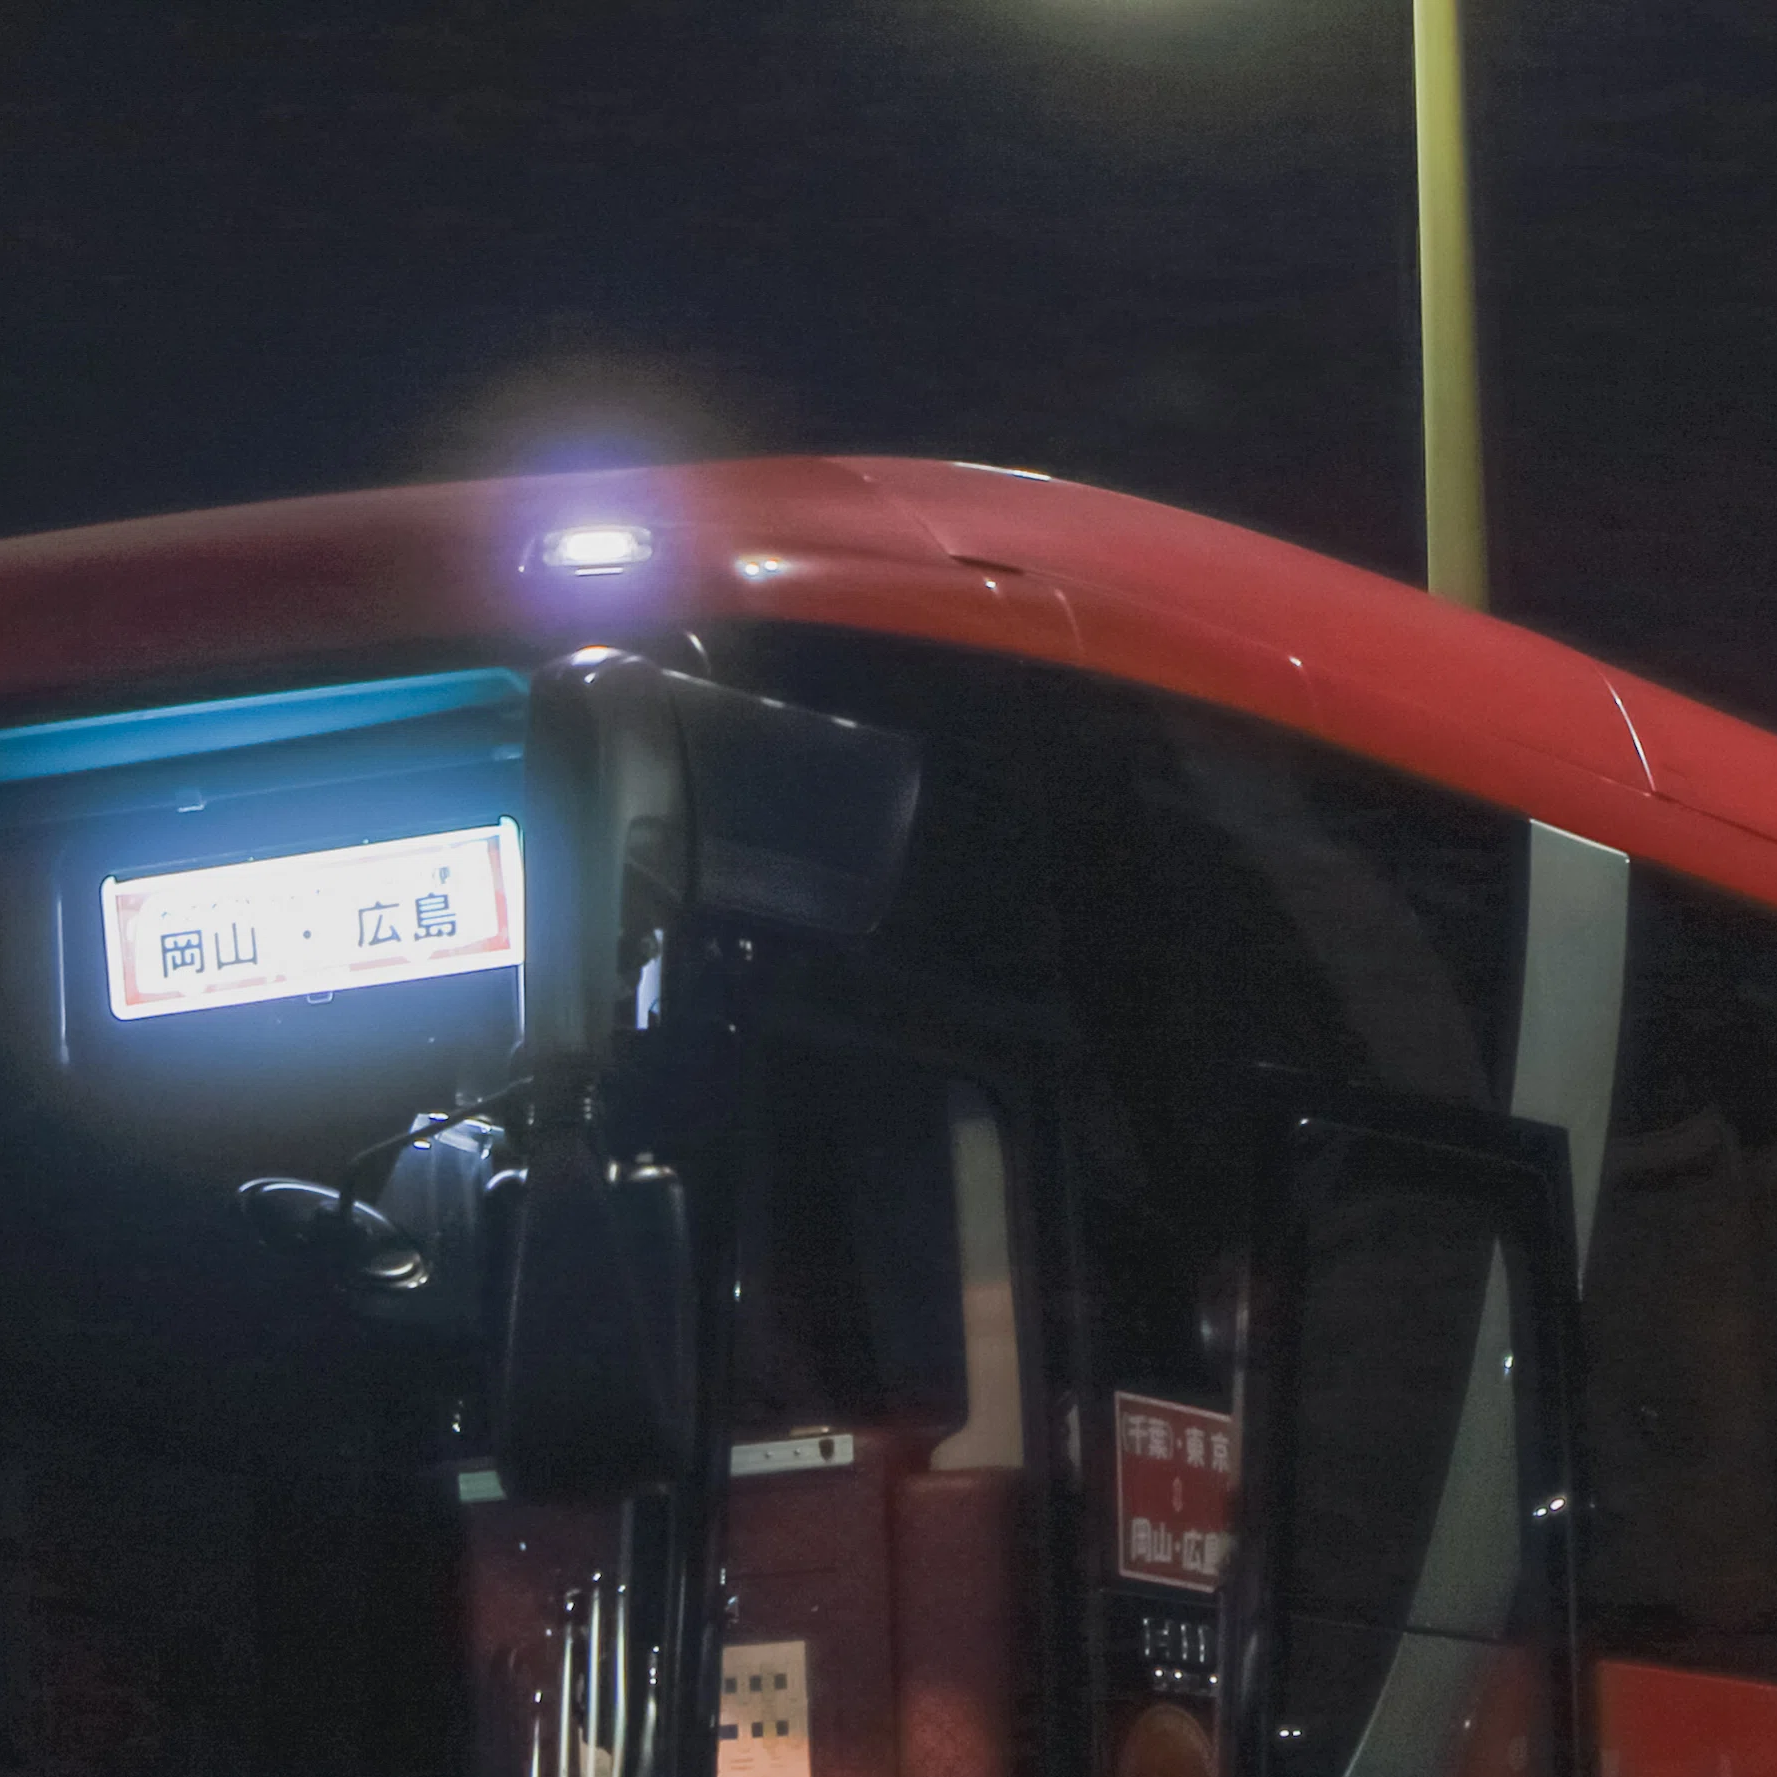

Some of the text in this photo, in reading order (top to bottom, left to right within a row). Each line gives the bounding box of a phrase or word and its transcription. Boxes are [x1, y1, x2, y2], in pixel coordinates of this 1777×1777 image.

[159, 891, 457, 978] 岡山・広島
